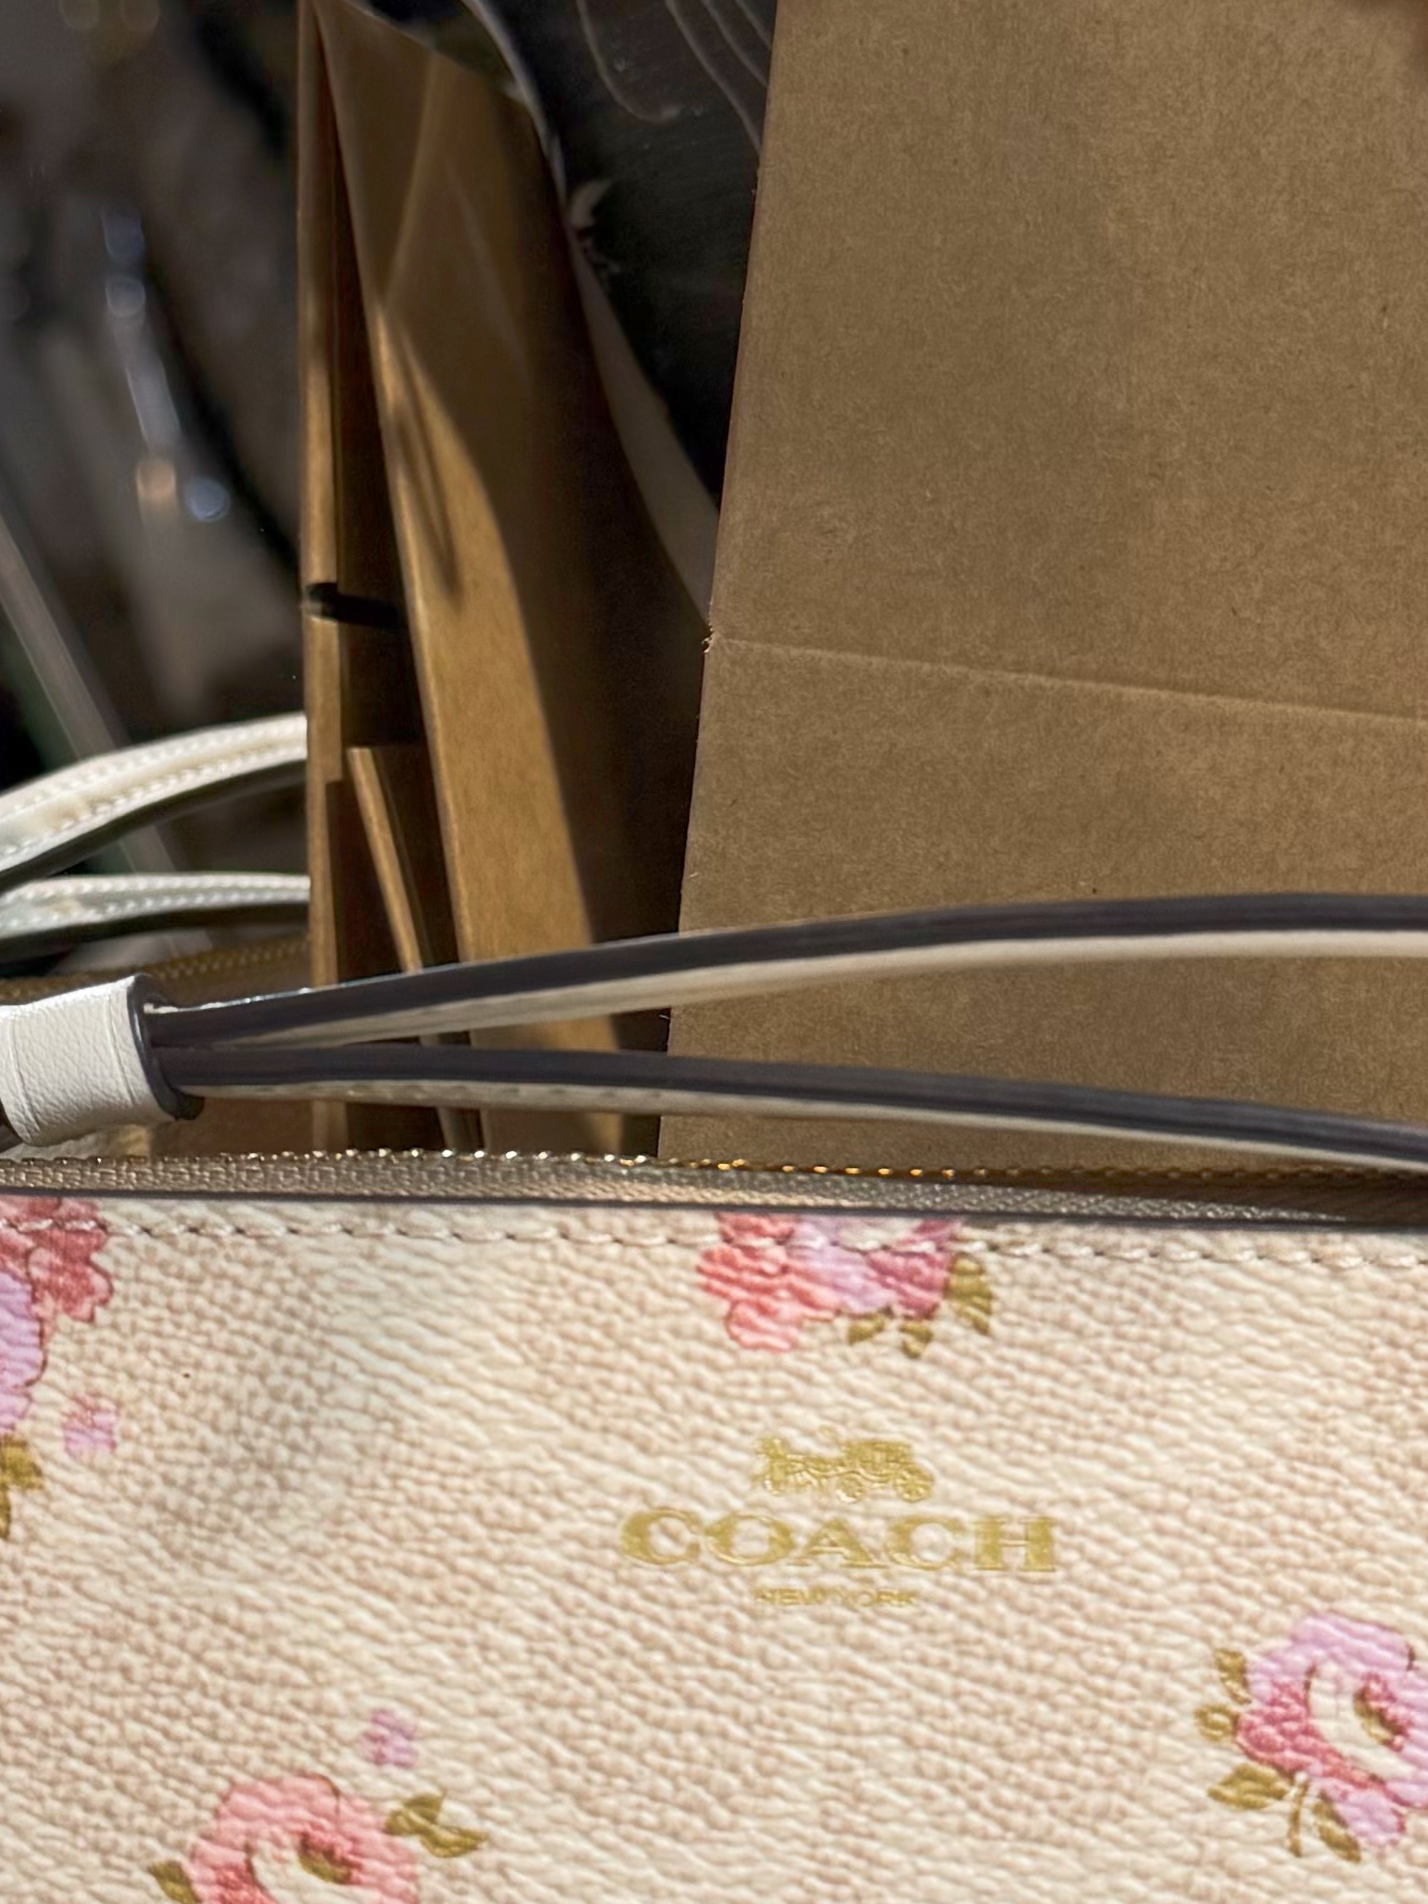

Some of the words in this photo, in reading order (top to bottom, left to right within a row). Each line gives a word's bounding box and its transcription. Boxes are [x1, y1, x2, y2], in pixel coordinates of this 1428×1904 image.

[619, 1505, 1058, 1572] COACH
[755, 1587, 829, 1608] NEW
[834, 1587, 919, 1609] YORK
